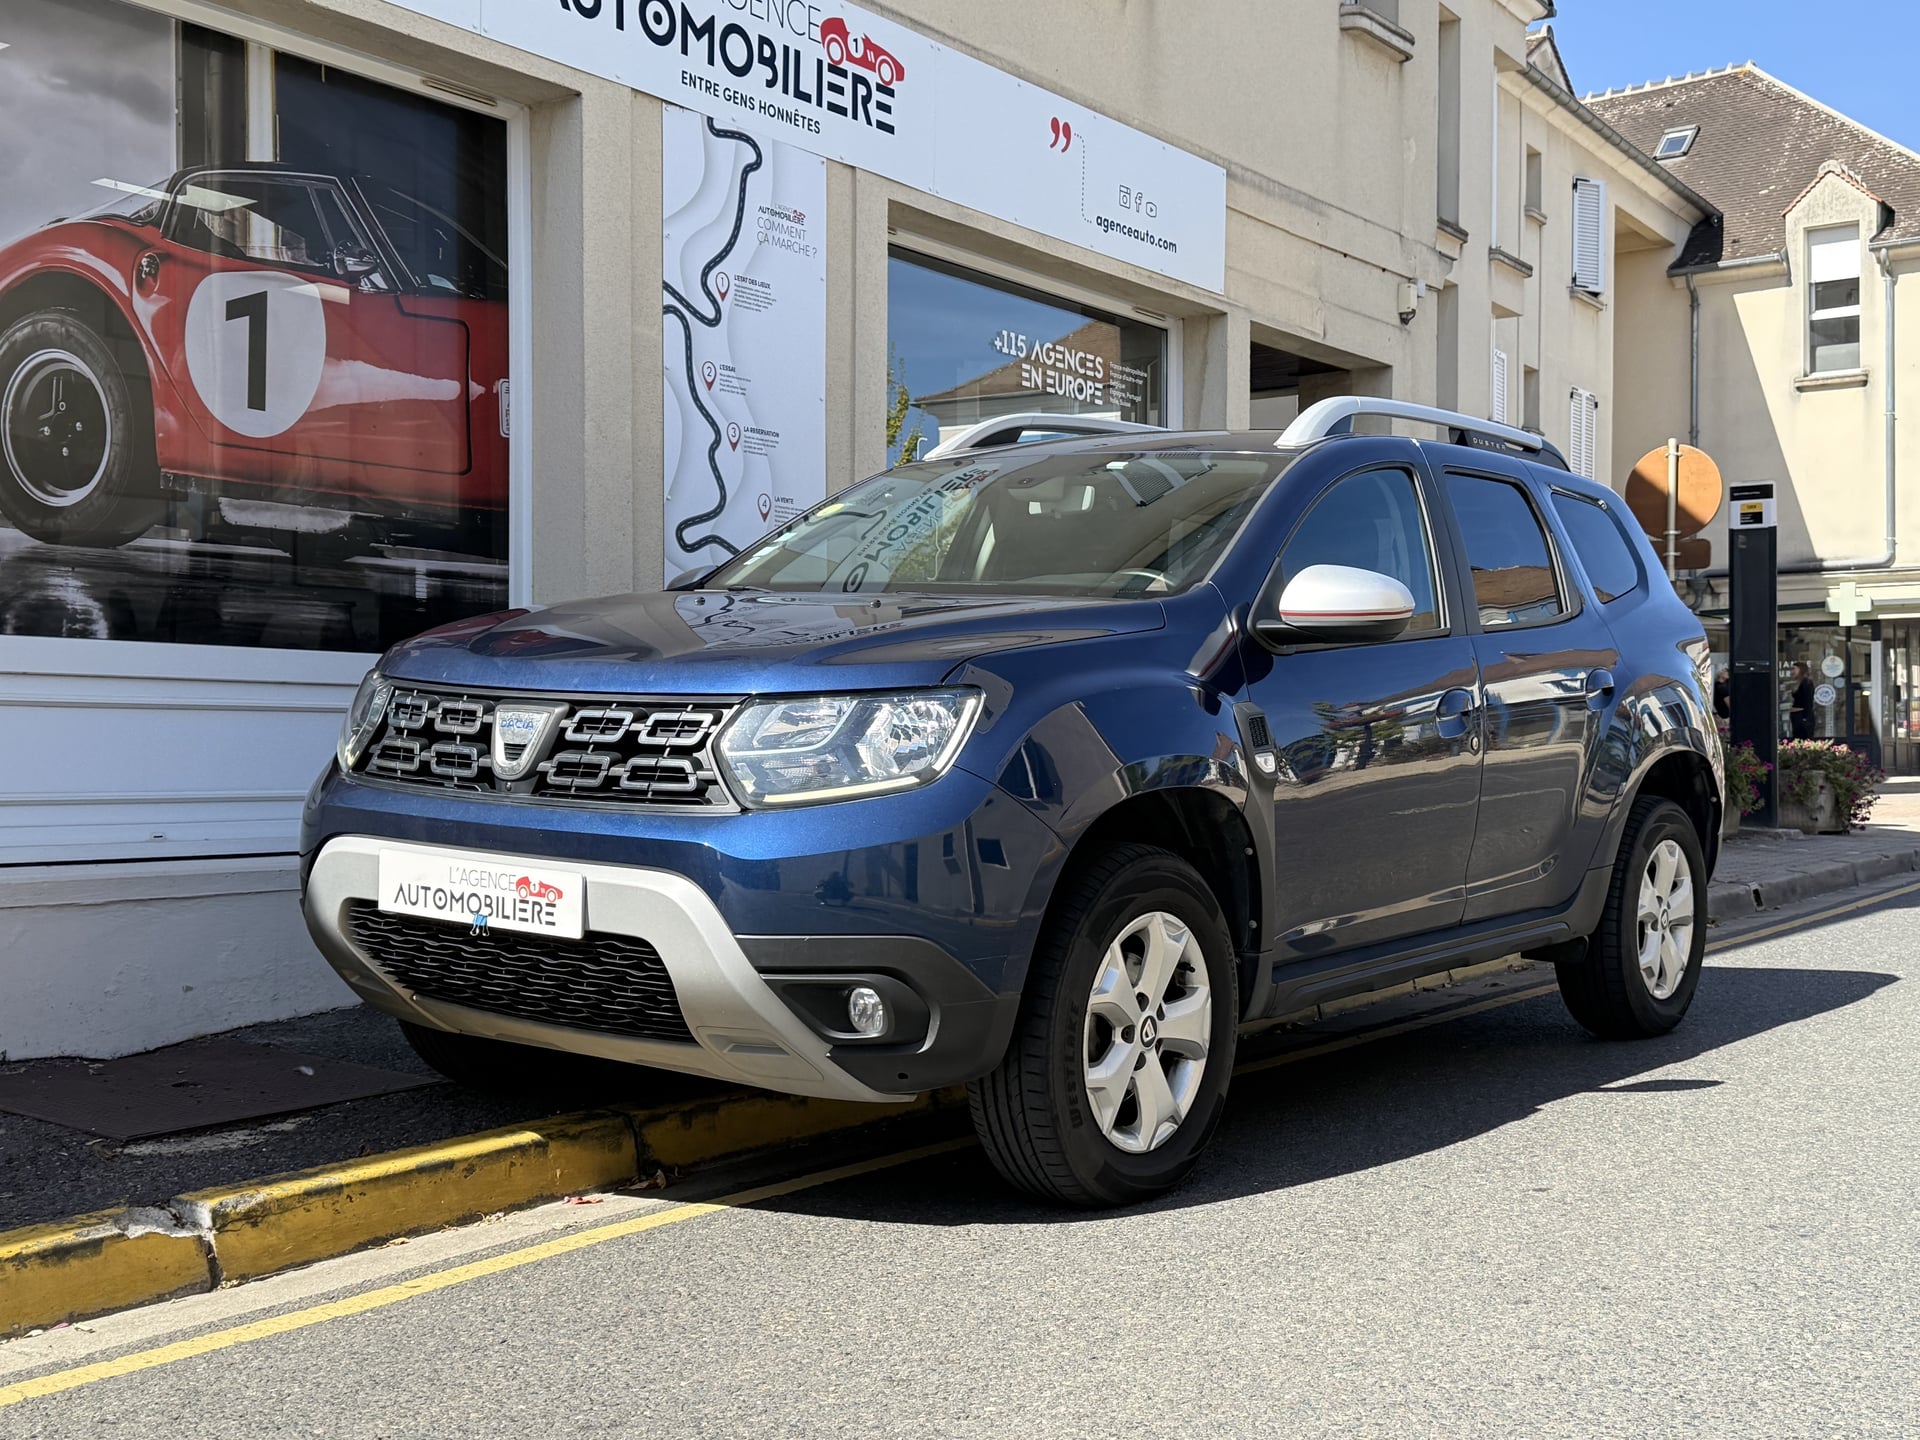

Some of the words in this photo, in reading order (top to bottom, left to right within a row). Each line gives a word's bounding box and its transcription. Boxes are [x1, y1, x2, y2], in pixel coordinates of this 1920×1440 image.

[559, 0, 895, 135] OMOBILIERE
[681, 70, 720, 98] ENTRE
[723, 87, 755, 111] GENS
[759, 101, 821, 135] HONNÊTES
[757, 216, 807, 241] COMMENT
[757, 231, 770, 246] ÇA
[1096, 215, 1177, 253] agenceauto.com
[225, 290, 268, 412] 1
[994, 329, 1027, 359] +115
[1031, 339, 1104, 379] AGENCES
[706, 366, 713, 378] 2
[1022, 363, 1042, 391] EN
[1046, 370, 1103, 405] EUROPE
[731, 427, 737, 438] 3
[1472, 437, 1506, 451] DUSTER
[762, 499, 768, 509] 4
[500, 718, 534, 731] DACIA
[449, 866, 517, 892] L'AGENCE
[1065, 1000, 1084, 1130] WESTLAKE
